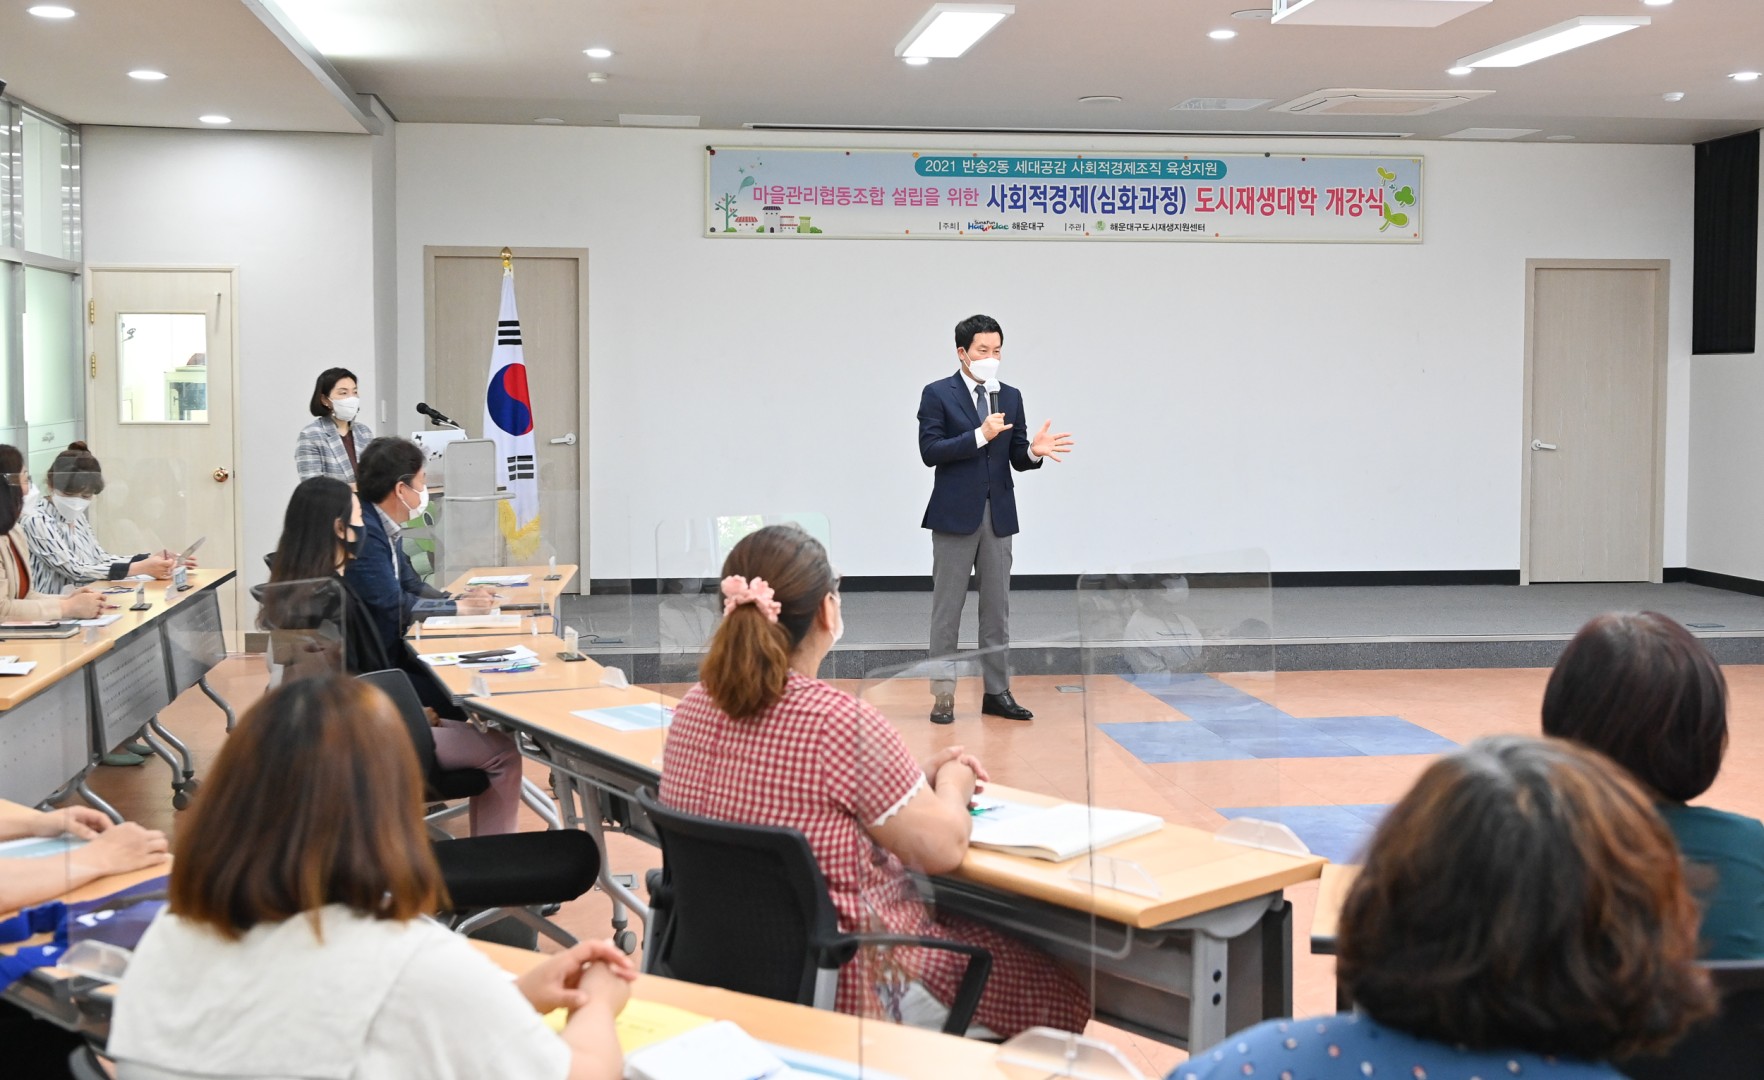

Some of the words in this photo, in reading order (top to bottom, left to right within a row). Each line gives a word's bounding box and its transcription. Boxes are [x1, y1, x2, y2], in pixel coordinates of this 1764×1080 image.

[925, 159, 956, 172] 2021
[962, 160, 1010, 174] 반송2동
[1014, 160, 1067, 175] 세대공감
[1071, 161, 1162, 176] 사회적경제조직
[1166, 161, 1218, 176] 육성지원
[753, 185, 885, 206] 마을관리협동조합
[891, 186, 941, 206] 설립을
[946, 187, 980, 207] 위한
[986, 184, 1187, 216] 사회적경제(심화과정)
[1194, 186, 1318, 217] 도시재생대학
[1325, 188, 1385, 217] 개강식
[1011, 222, 1045, 231] 해운대구
[1109, 222, 1206, 232] 해운대구도시재생지원센터
